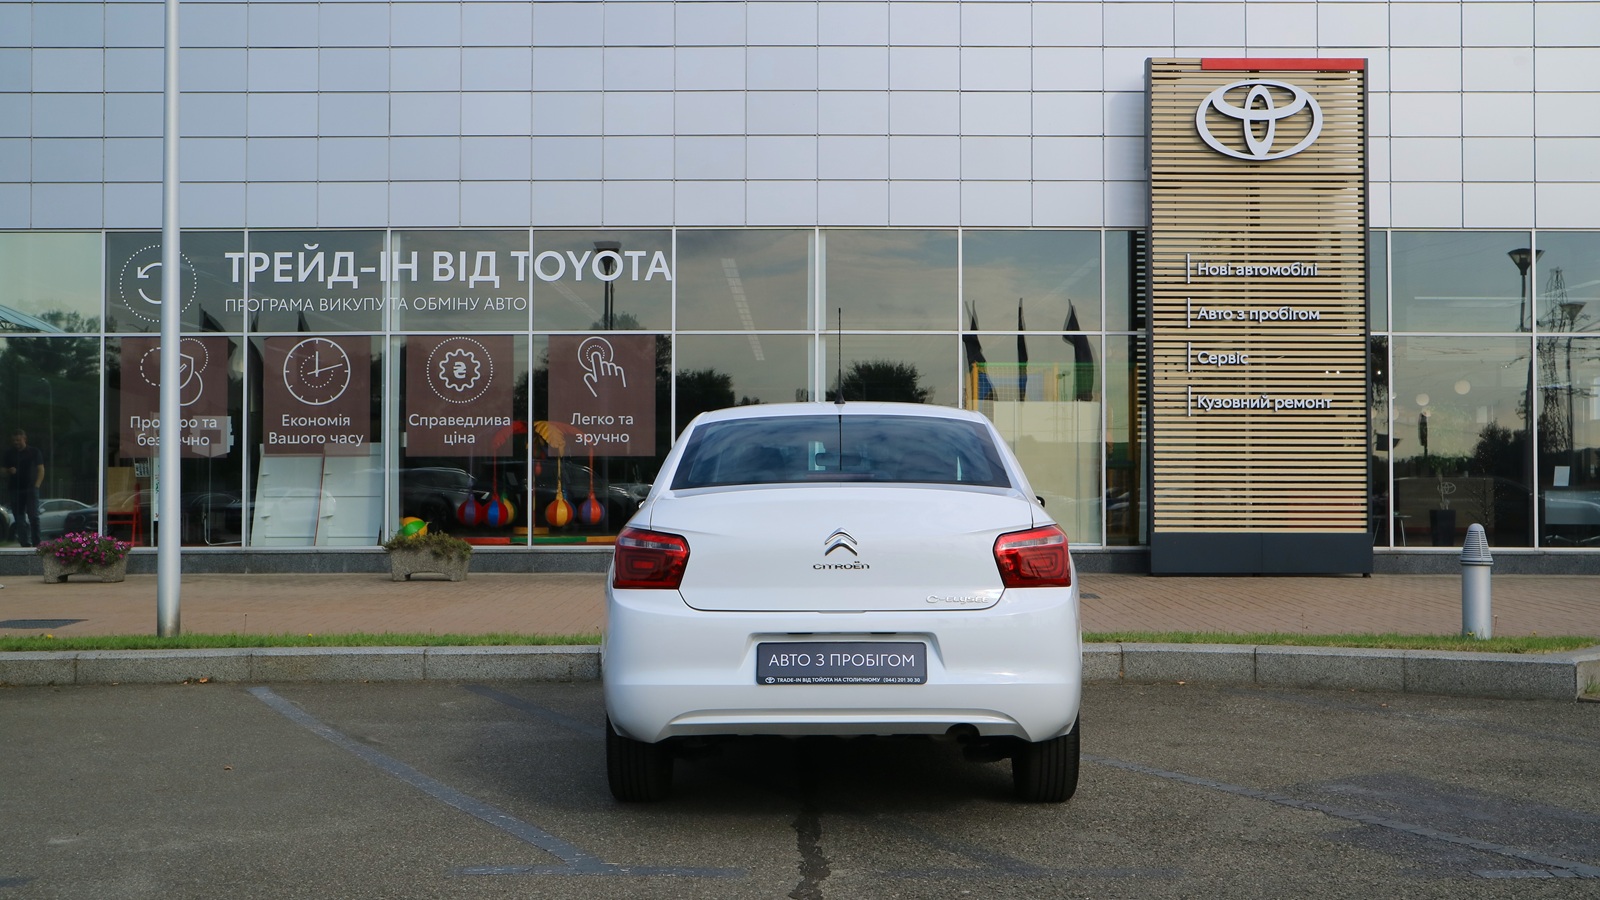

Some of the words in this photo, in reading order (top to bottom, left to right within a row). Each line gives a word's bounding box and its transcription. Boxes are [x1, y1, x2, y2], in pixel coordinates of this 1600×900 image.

[225, 243, 418, 289] ТРЕЙД-ІН
[433, 251, 500, 289] ВІД
[511, 250, 672, 281] TOYOTA
[1197, 262, 1232, 276] Нові
[1236, 262, 1318, 276] автомобілі
[225, 298, 314, 312] ПРОГРАМА
[320, 297, 386, 311] ВИКУПУ
[390, 297, 409, 310] ТА
[413, 296, 479, 311] ОБМІНУ
[484, 296, 527, 311] АВТО
[1197, 307, 1233, 321] Авто
[1236, 310, 1245, 321] з
[1249, 306, 1320, 323] пробігом
[1197, 351, 1249, 367] Сервіс
[1197, 395, 1270, 412] Кузовний
[1275, 398, 1332, 412] ремонт
[130, 415, 198, 432] Проро
[201, 418, 217, 428] та
[281, 413, 351, 427] Економія
[408, 413, 511, 429] Справедлива
[570, 412, 615, 425] Легко
[618, 414, 634, 425] та
[268, 432, 326, 444] Вашого
[330, 434, 364, 447] часу
[443, 431, 476, 445] ціна
[575, 432, 631, 446] зручно
[768, 653, 811, 667] АВТО
[815, 654, 825, 667] З
[830, 653, 915, 667] ПРОБІГОМ
